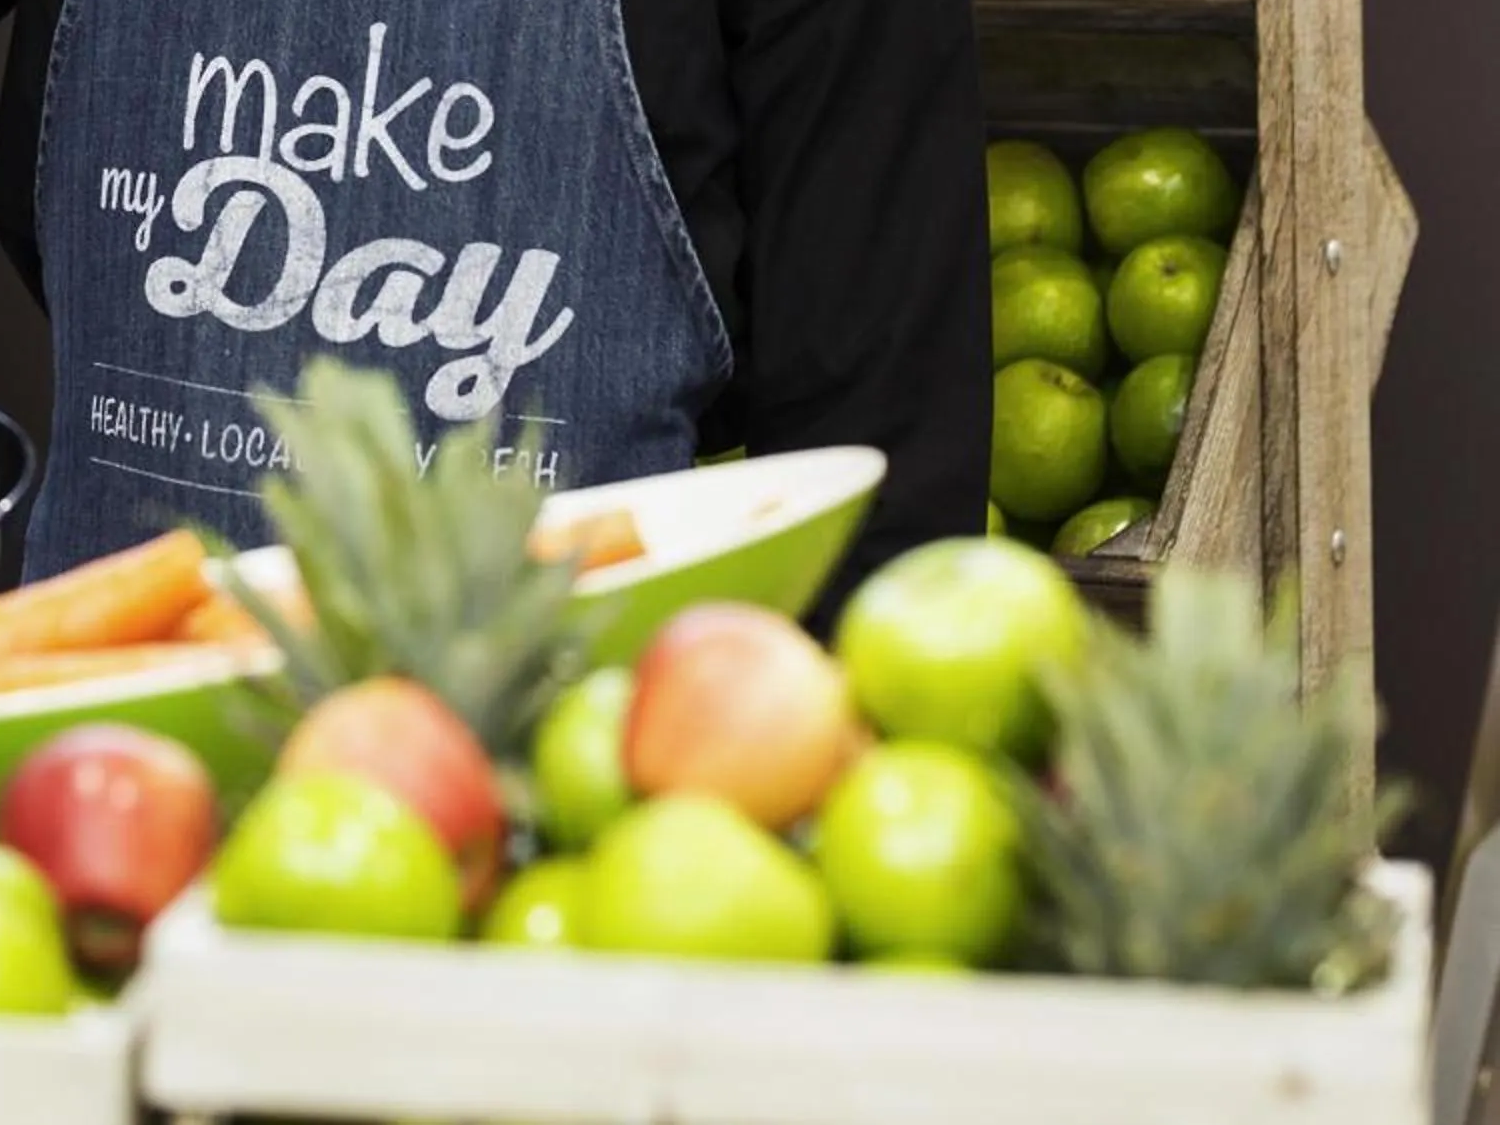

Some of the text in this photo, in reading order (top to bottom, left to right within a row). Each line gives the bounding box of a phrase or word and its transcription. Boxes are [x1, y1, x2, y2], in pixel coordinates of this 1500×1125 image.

[182, 21, 495, 191] make
[99, 155, 575, 422] my Day
[91, 394, 184, 454] HEALTHY
